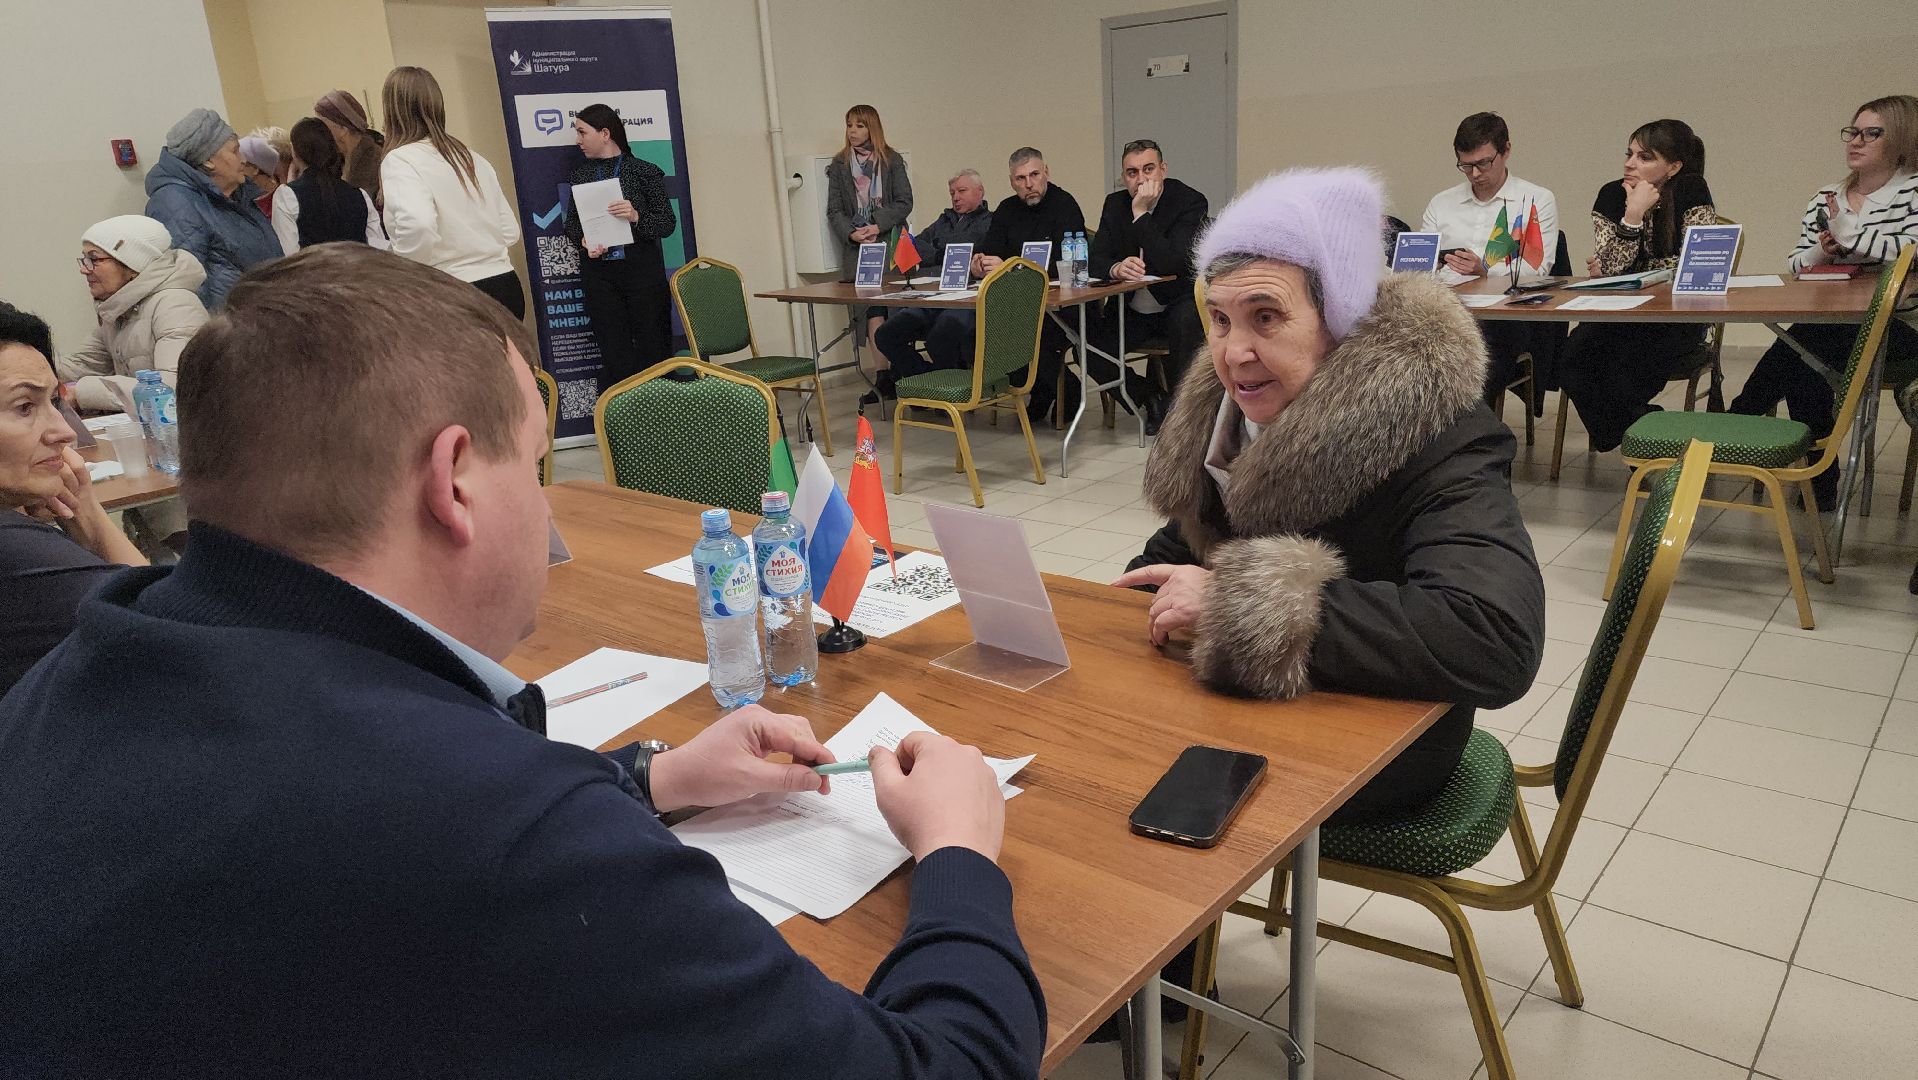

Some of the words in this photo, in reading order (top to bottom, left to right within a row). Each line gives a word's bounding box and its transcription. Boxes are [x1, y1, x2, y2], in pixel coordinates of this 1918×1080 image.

[533, 63, 570, 74] Шатура
[544, 290, 573, 301] НАМ
[546, 303, 584, 315] ВАШЕ
[549, 316, 591, 329] МНЕНИ
[771, 557, 796, 568] МОЯ
[765, 564, 803, 577] СТИХИЯ
